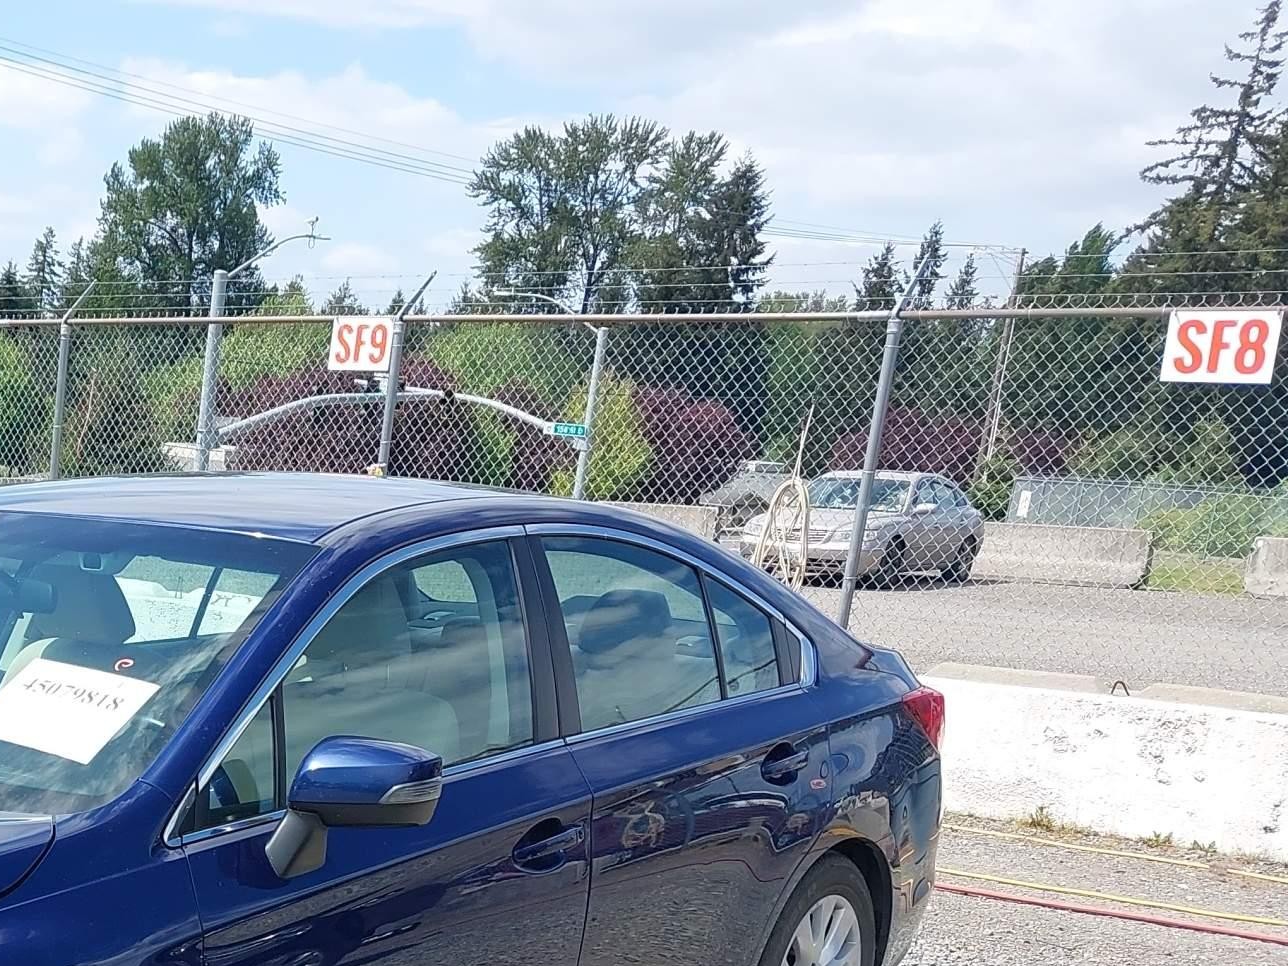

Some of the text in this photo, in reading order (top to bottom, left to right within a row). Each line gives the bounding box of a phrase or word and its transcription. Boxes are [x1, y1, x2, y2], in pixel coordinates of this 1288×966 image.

[334, 324, 389, 365] SF9
[1173, 319, 1269, 375] SF8
[24, 677, 125, 712] 45079818
